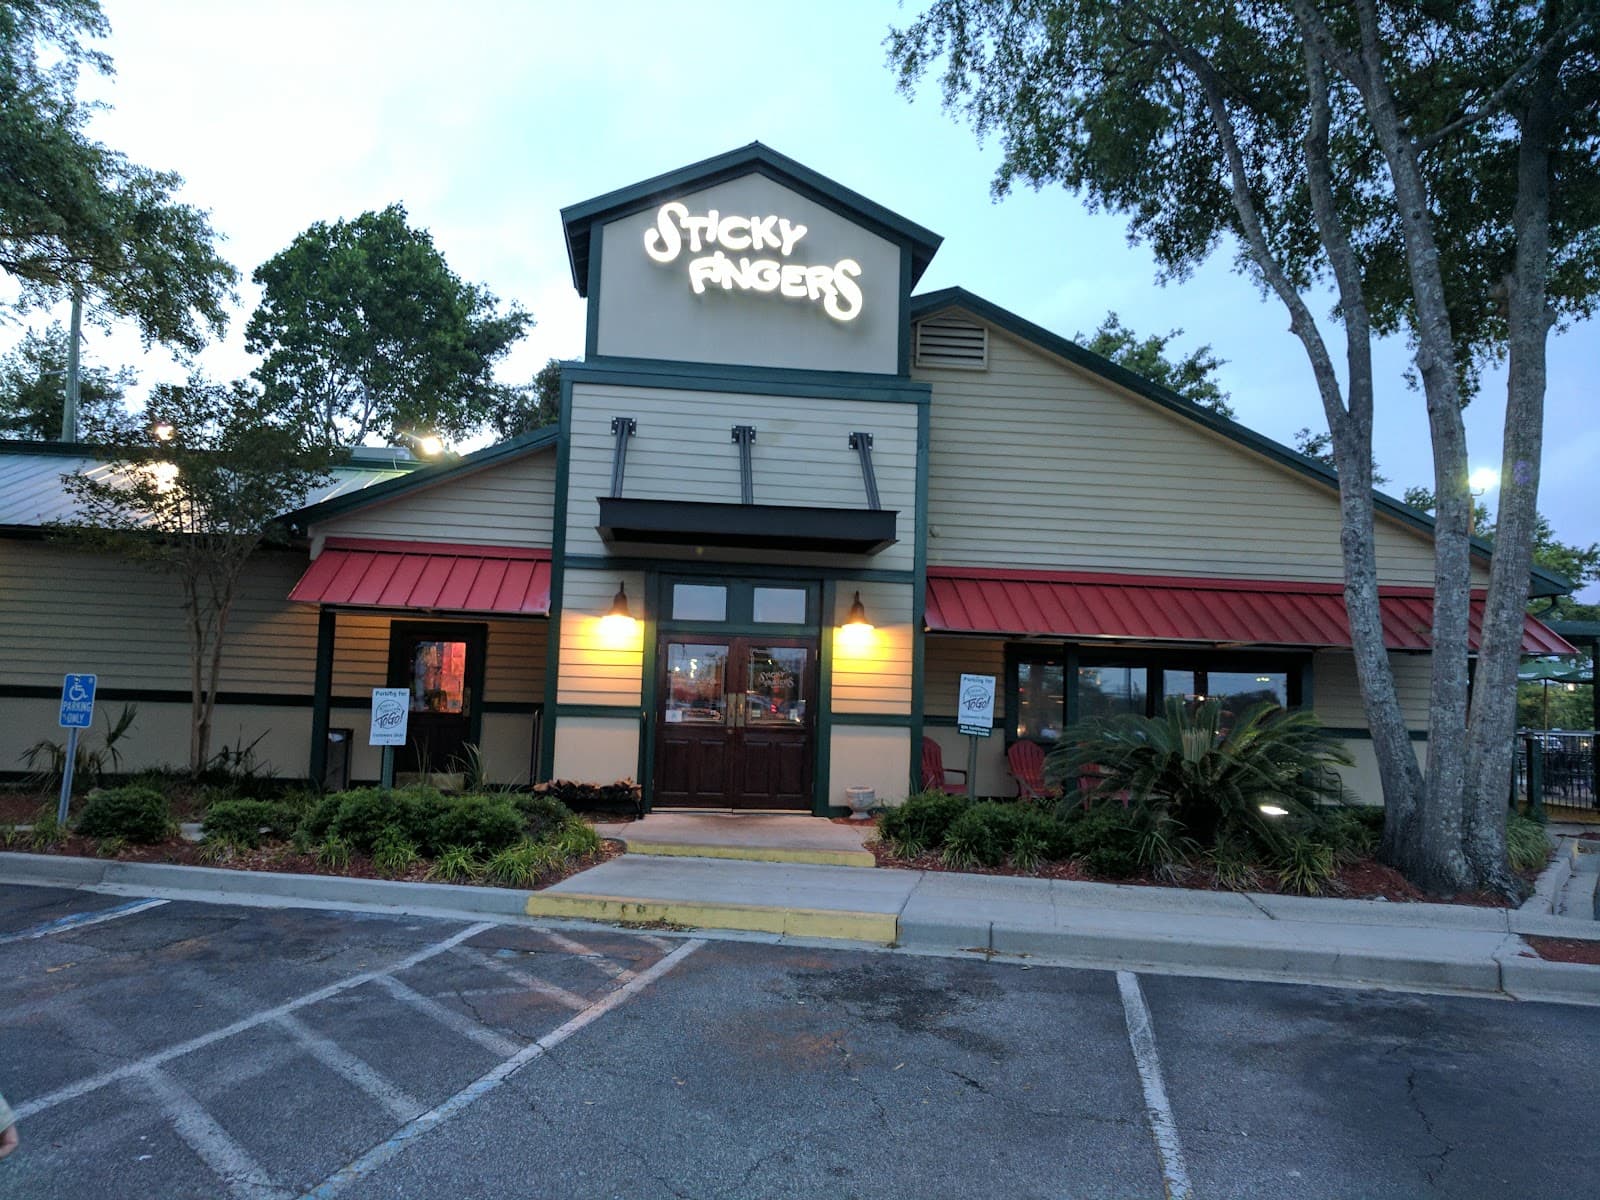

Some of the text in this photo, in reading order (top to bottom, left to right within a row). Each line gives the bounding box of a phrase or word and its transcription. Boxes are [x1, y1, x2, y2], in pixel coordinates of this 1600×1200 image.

[643, 201, 807, 263] STICKY
[688, 250, 863, 321] FINGERS
[62, 701, 92, 713] PARKING
[375, 690, 397, 698] Parking
